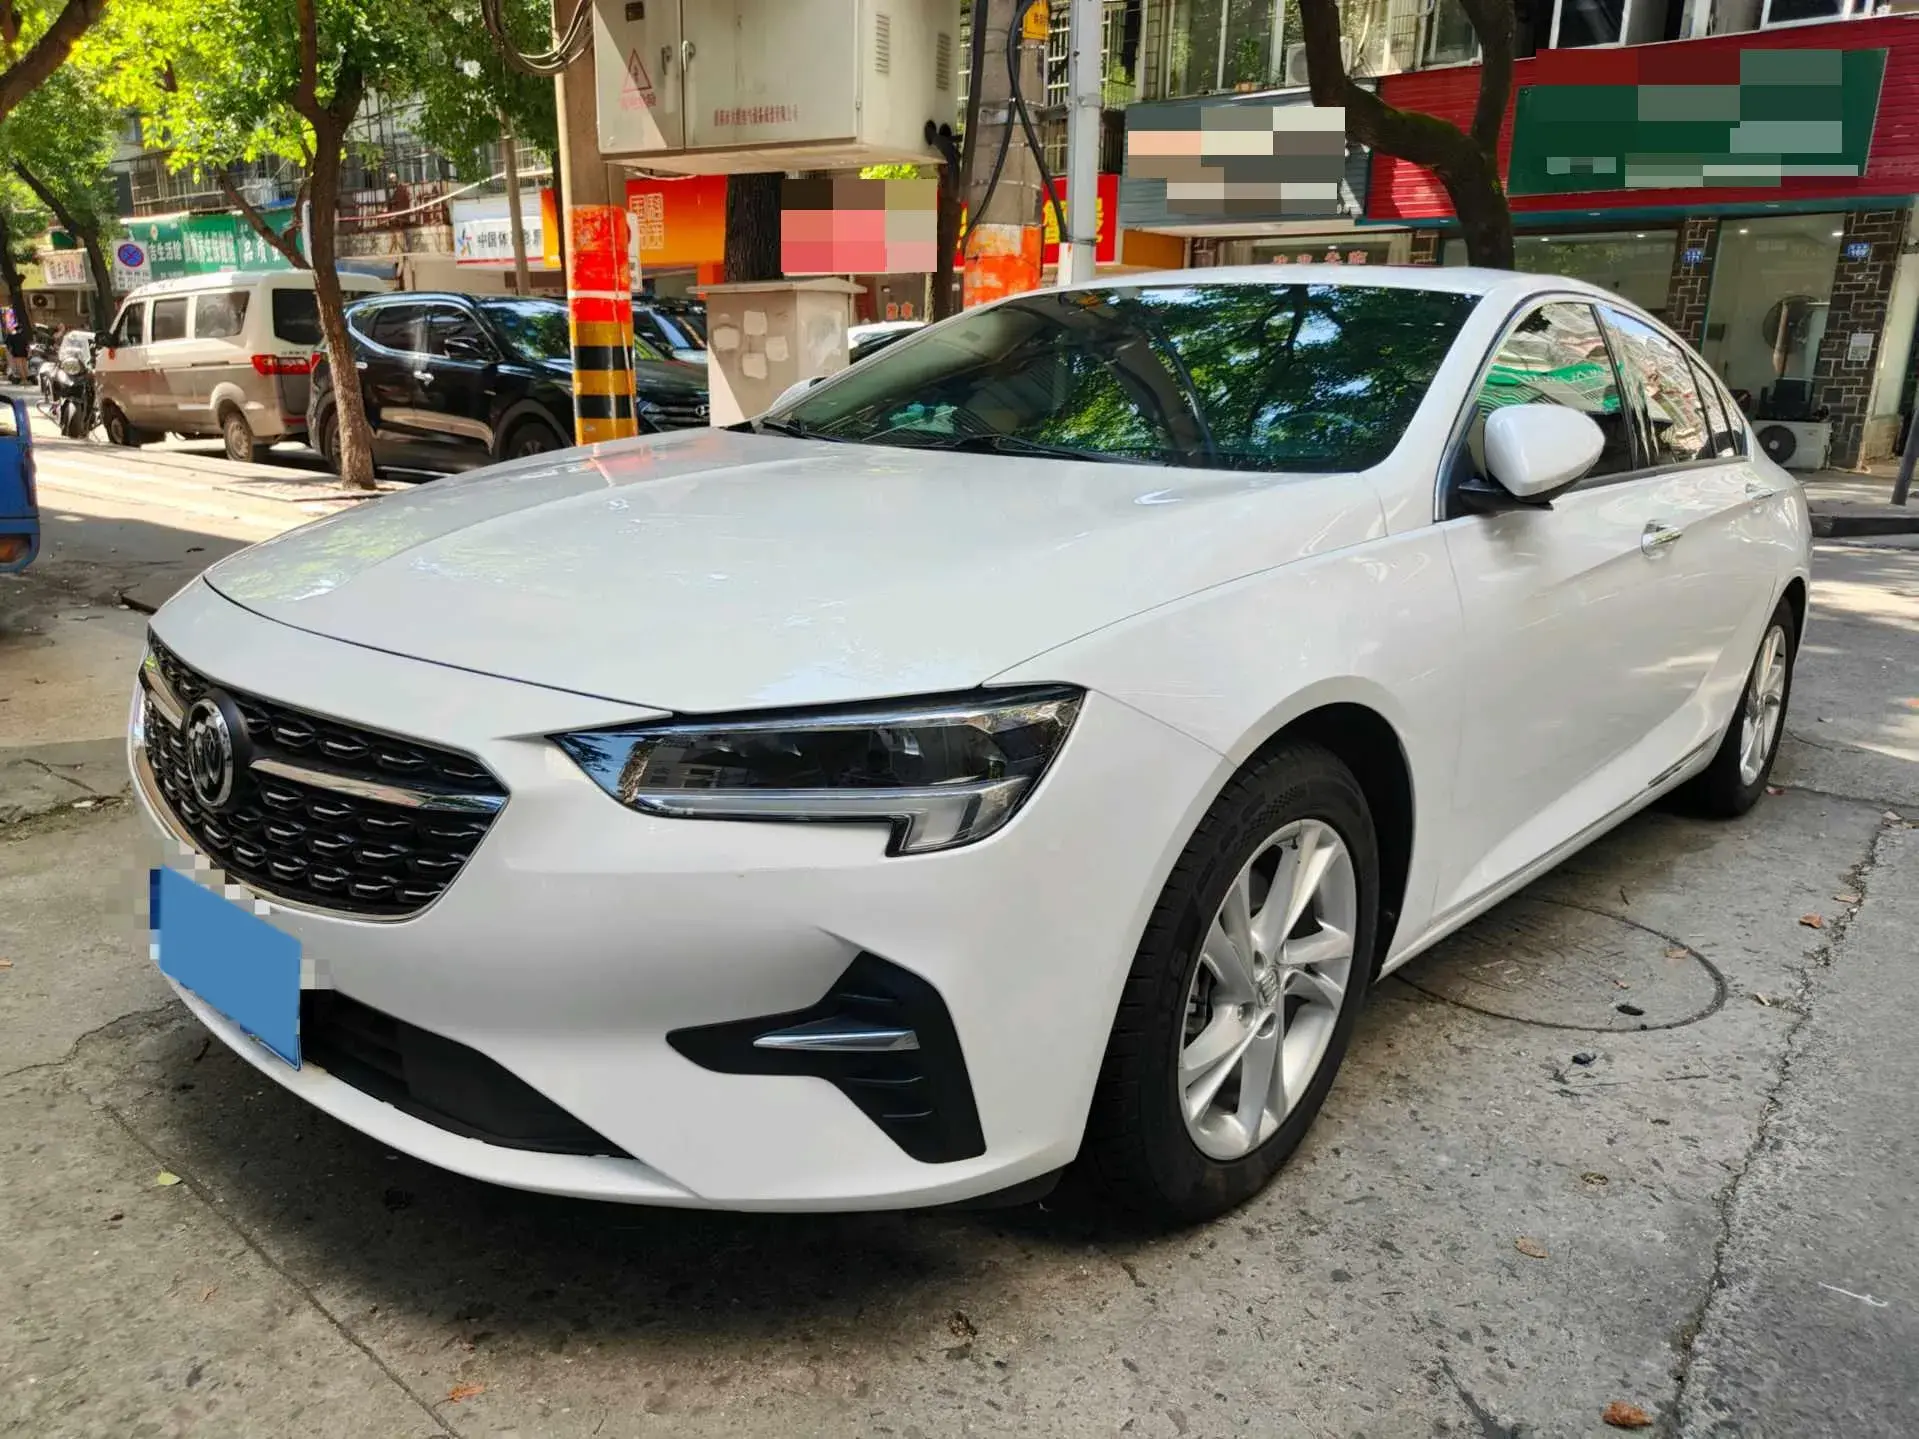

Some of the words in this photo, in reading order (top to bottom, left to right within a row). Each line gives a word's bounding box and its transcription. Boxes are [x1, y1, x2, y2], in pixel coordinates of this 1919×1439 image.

[477, 229, 542, 248] 中国体彩票
